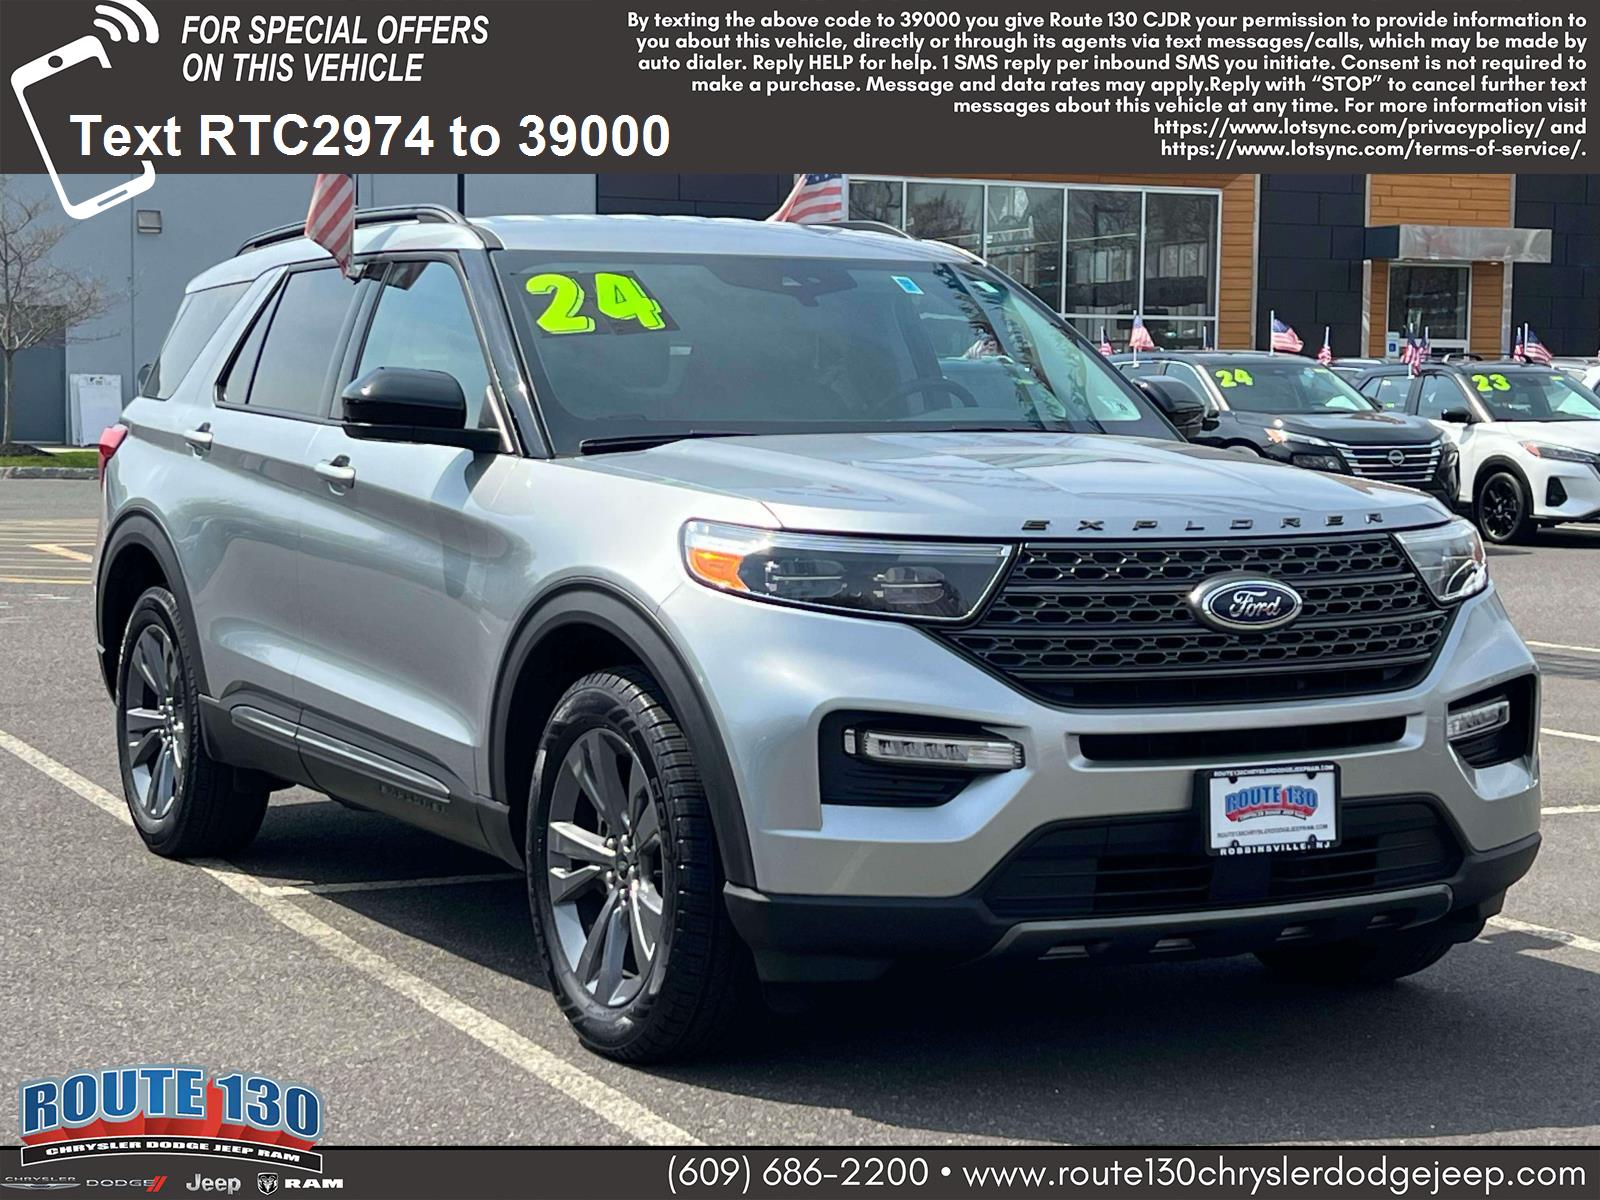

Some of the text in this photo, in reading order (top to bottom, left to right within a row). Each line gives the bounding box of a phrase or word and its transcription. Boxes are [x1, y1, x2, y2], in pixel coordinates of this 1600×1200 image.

[526, 273, 666, 334] 24
[1215, 368, 1253, 388] 24
[1471, 373, 1512, 392] 23
[1021, 512, 1383, 531] EXPLORER
[1229, 591, 1281, 617] Ford
[1226, 786, 1317, 813] ROUTE 130
